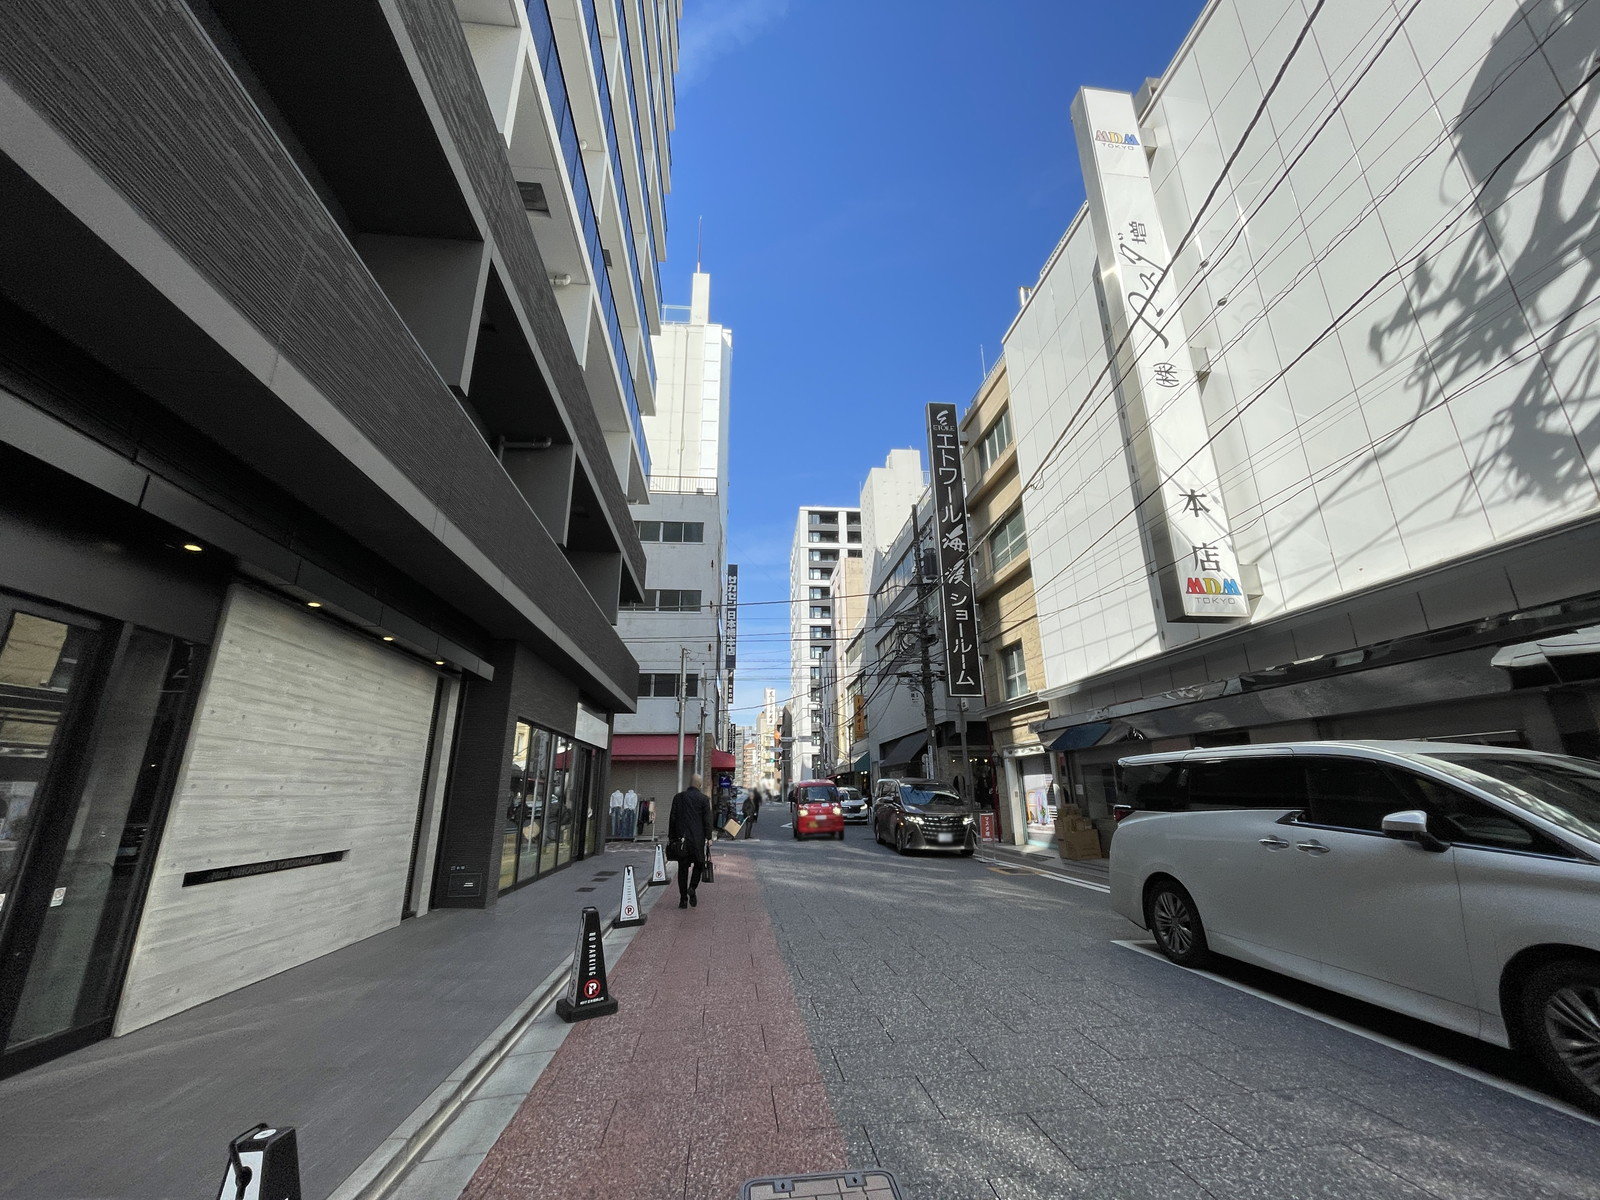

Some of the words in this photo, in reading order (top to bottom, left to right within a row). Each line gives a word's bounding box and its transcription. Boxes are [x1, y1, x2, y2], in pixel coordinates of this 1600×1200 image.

[1094, 129, 1141, 146] MDM
[1101, 142, 1135, 151] TOKYO
[1185, 577, 1242, 596] MDM
[1195, 596, 1236, 605] TOKYO
[588, 931, 597, 942] NO
[588, 944, 597, 976] PARKING
